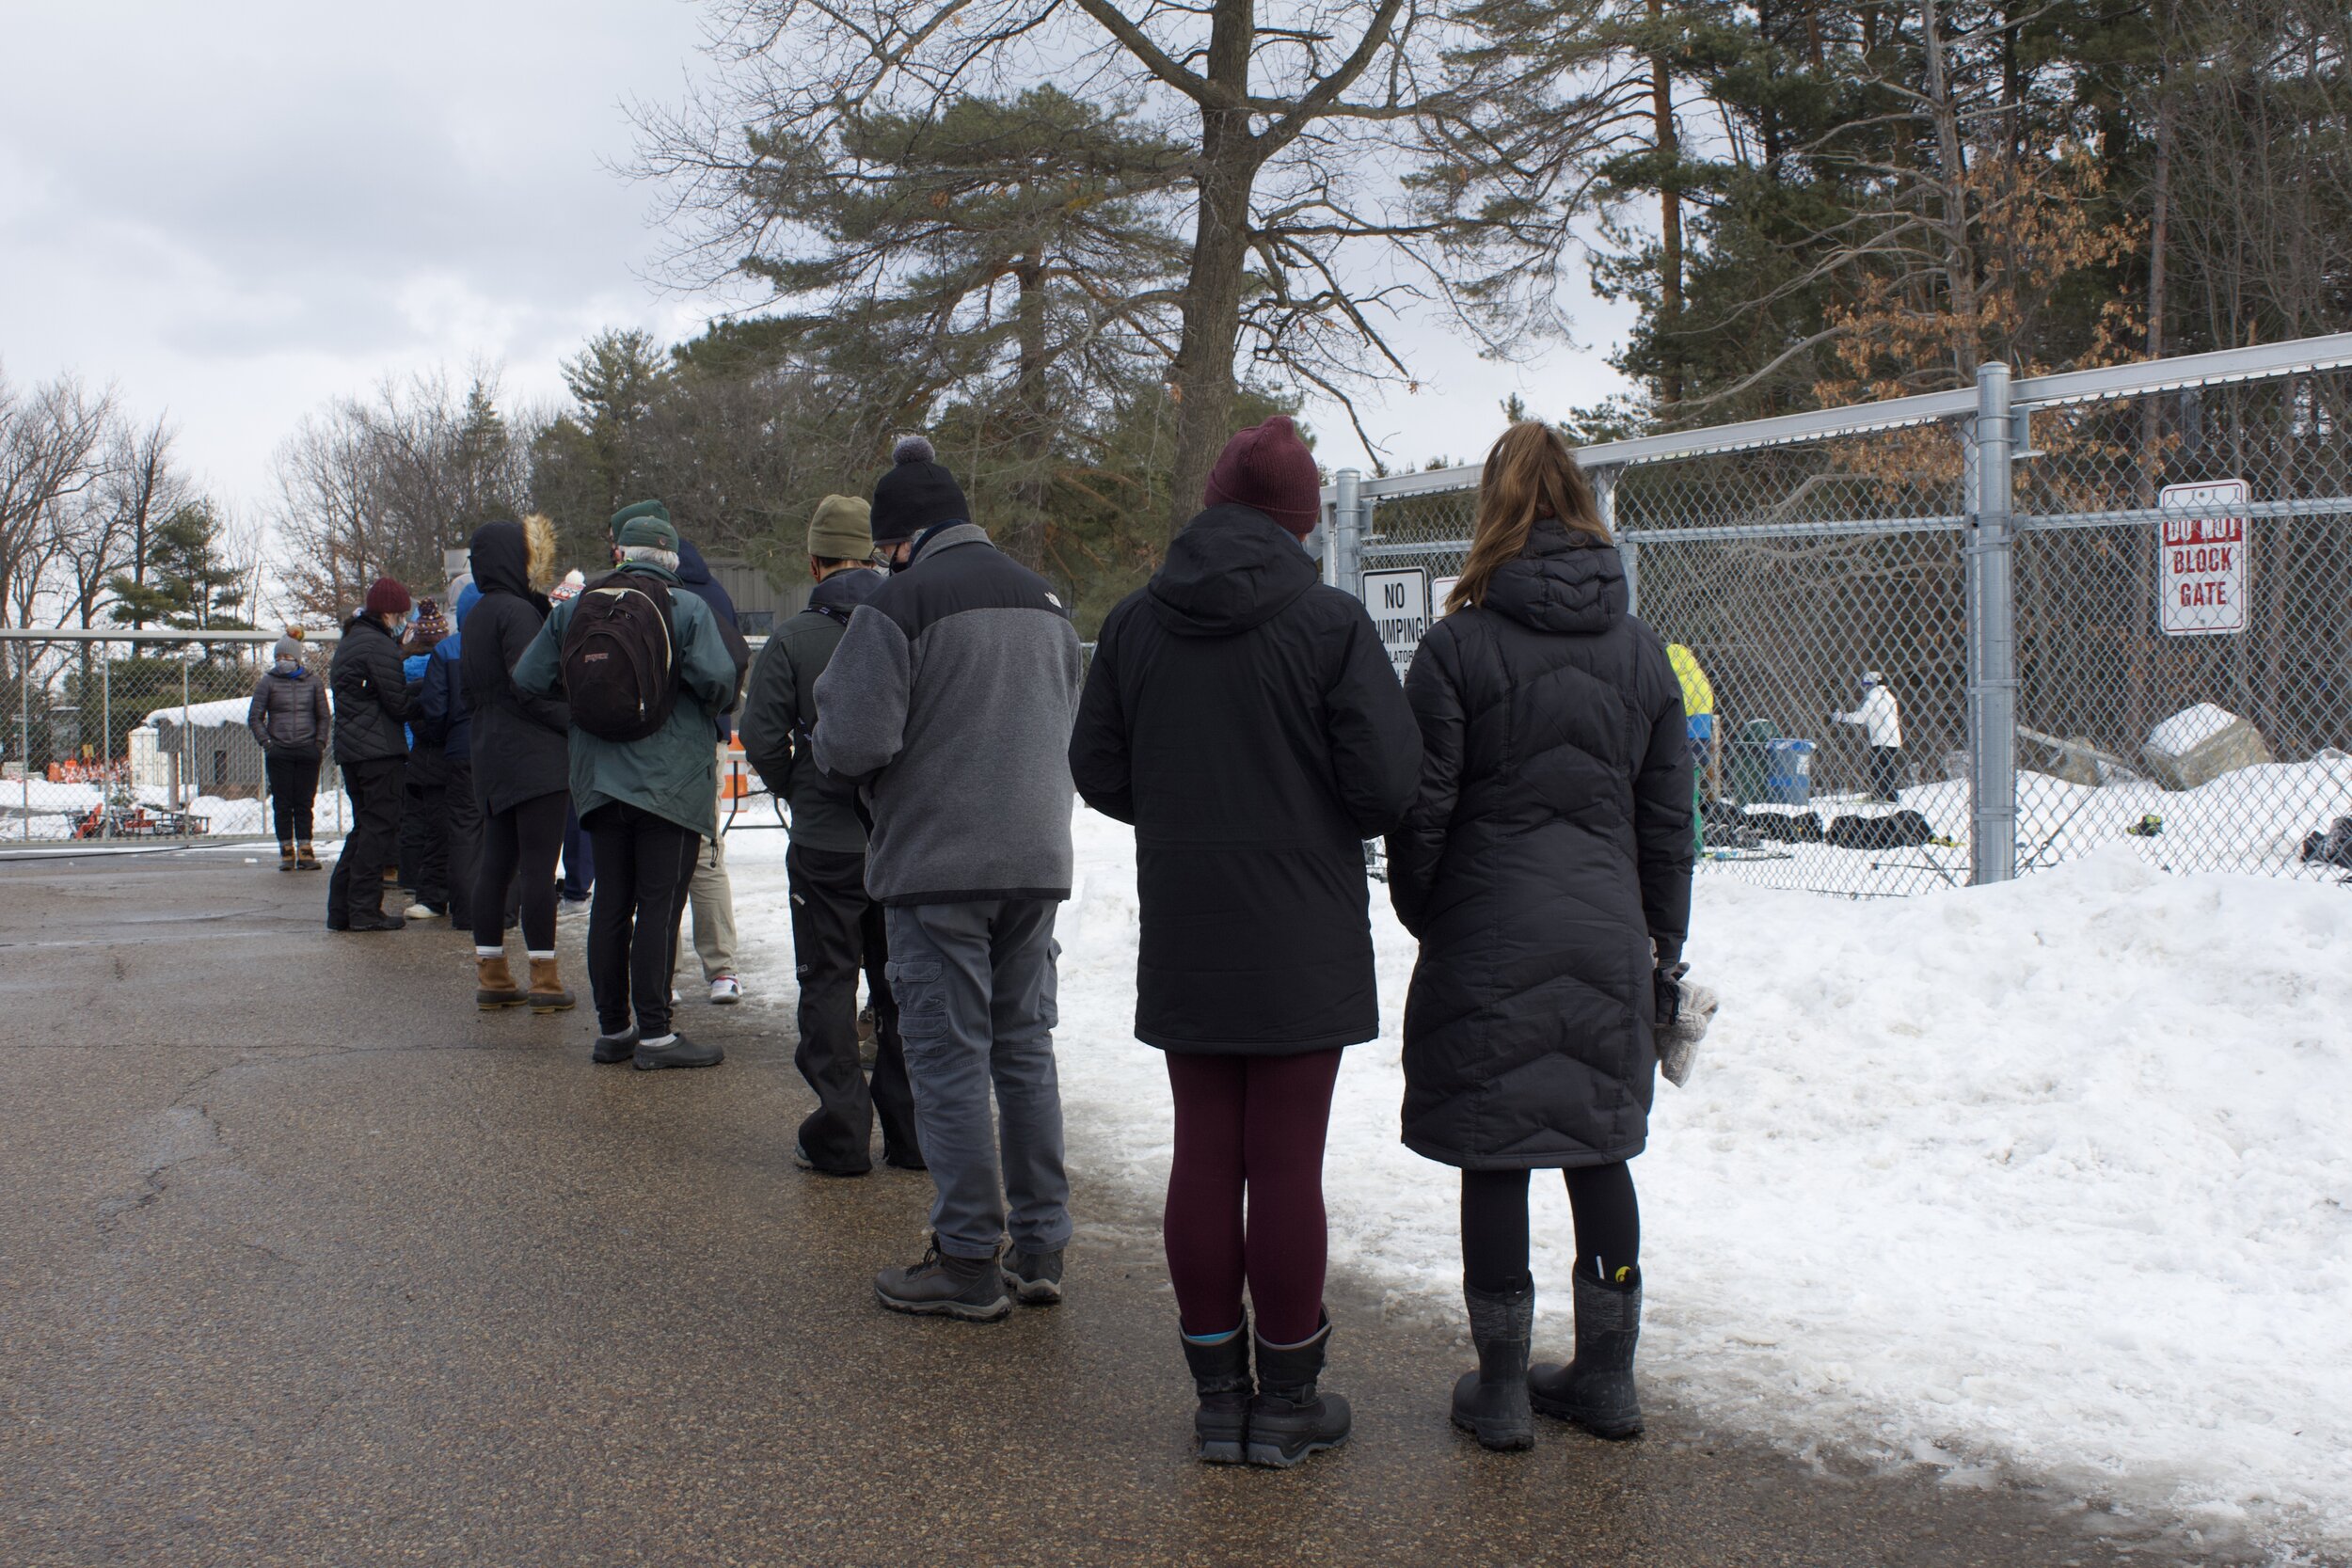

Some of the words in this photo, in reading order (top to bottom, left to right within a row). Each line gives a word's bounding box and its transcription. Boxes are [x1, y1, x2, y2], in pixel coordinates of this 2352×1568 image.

[2168, 520, 2192, 542] DO
[2173, 547, 2232, 573] BLOCK
[1385, 582, 1405, 609] NO
[2181, 581, 2227, 607] GATE
